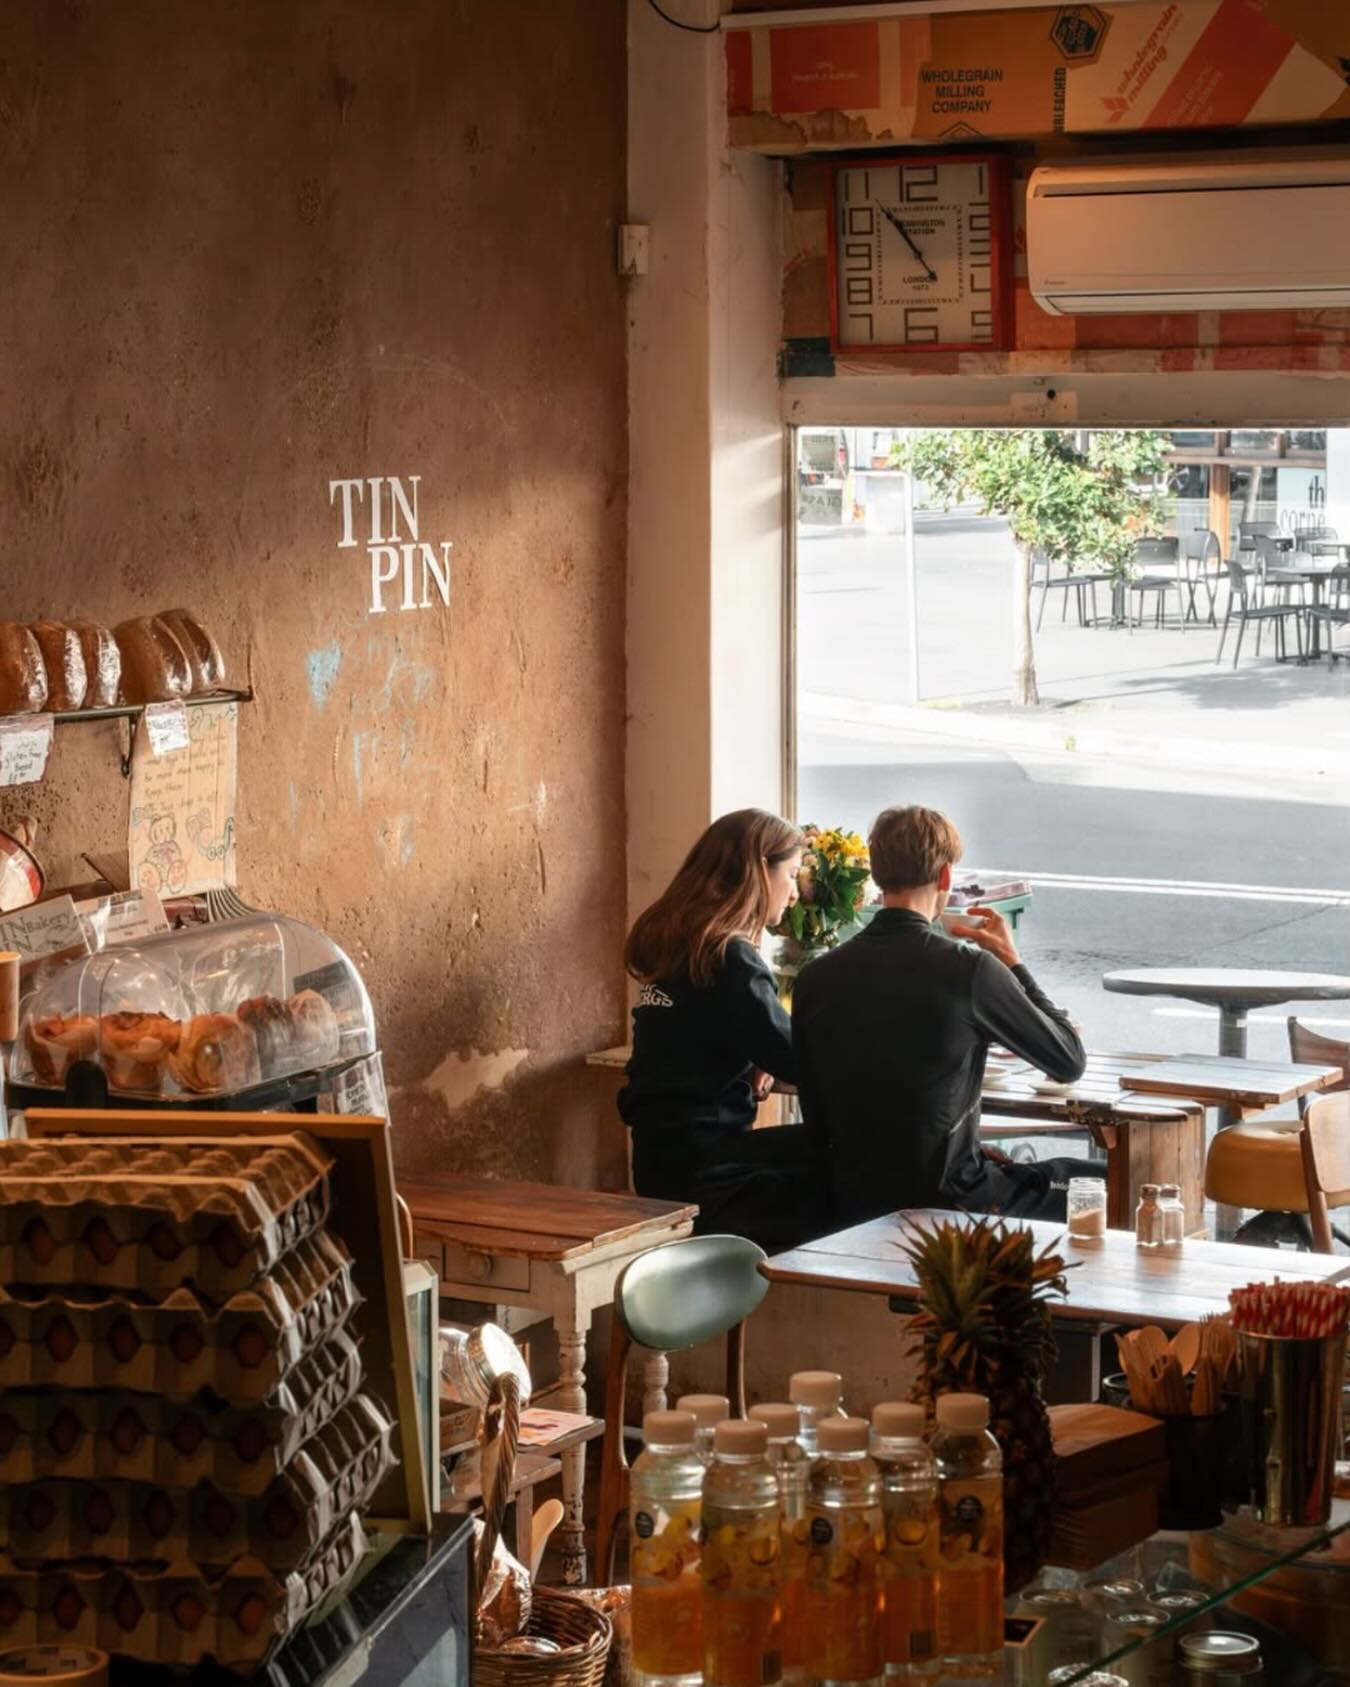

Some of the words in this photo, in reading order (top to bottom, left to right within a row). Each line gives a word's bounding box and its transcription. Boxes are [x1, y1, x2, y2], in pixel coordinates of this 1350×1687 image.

[921, 68, 1003, 83] WHOLEGRAIN
[935, 84, 985, 98] MILLING
[932, 99, 991, 114] COMPANY
[899, 165, 938, 202] 12
[846, 243, 872, 271] 9
[847, 277, 874, 305] 8
[902, 275, 938, 284] LONDO
[849, 313, 873, 341] 7
[904, 308, 938, 344] 6
[329, 475, 421, 548] TIN
[366, 541, 453, 614] PIN
